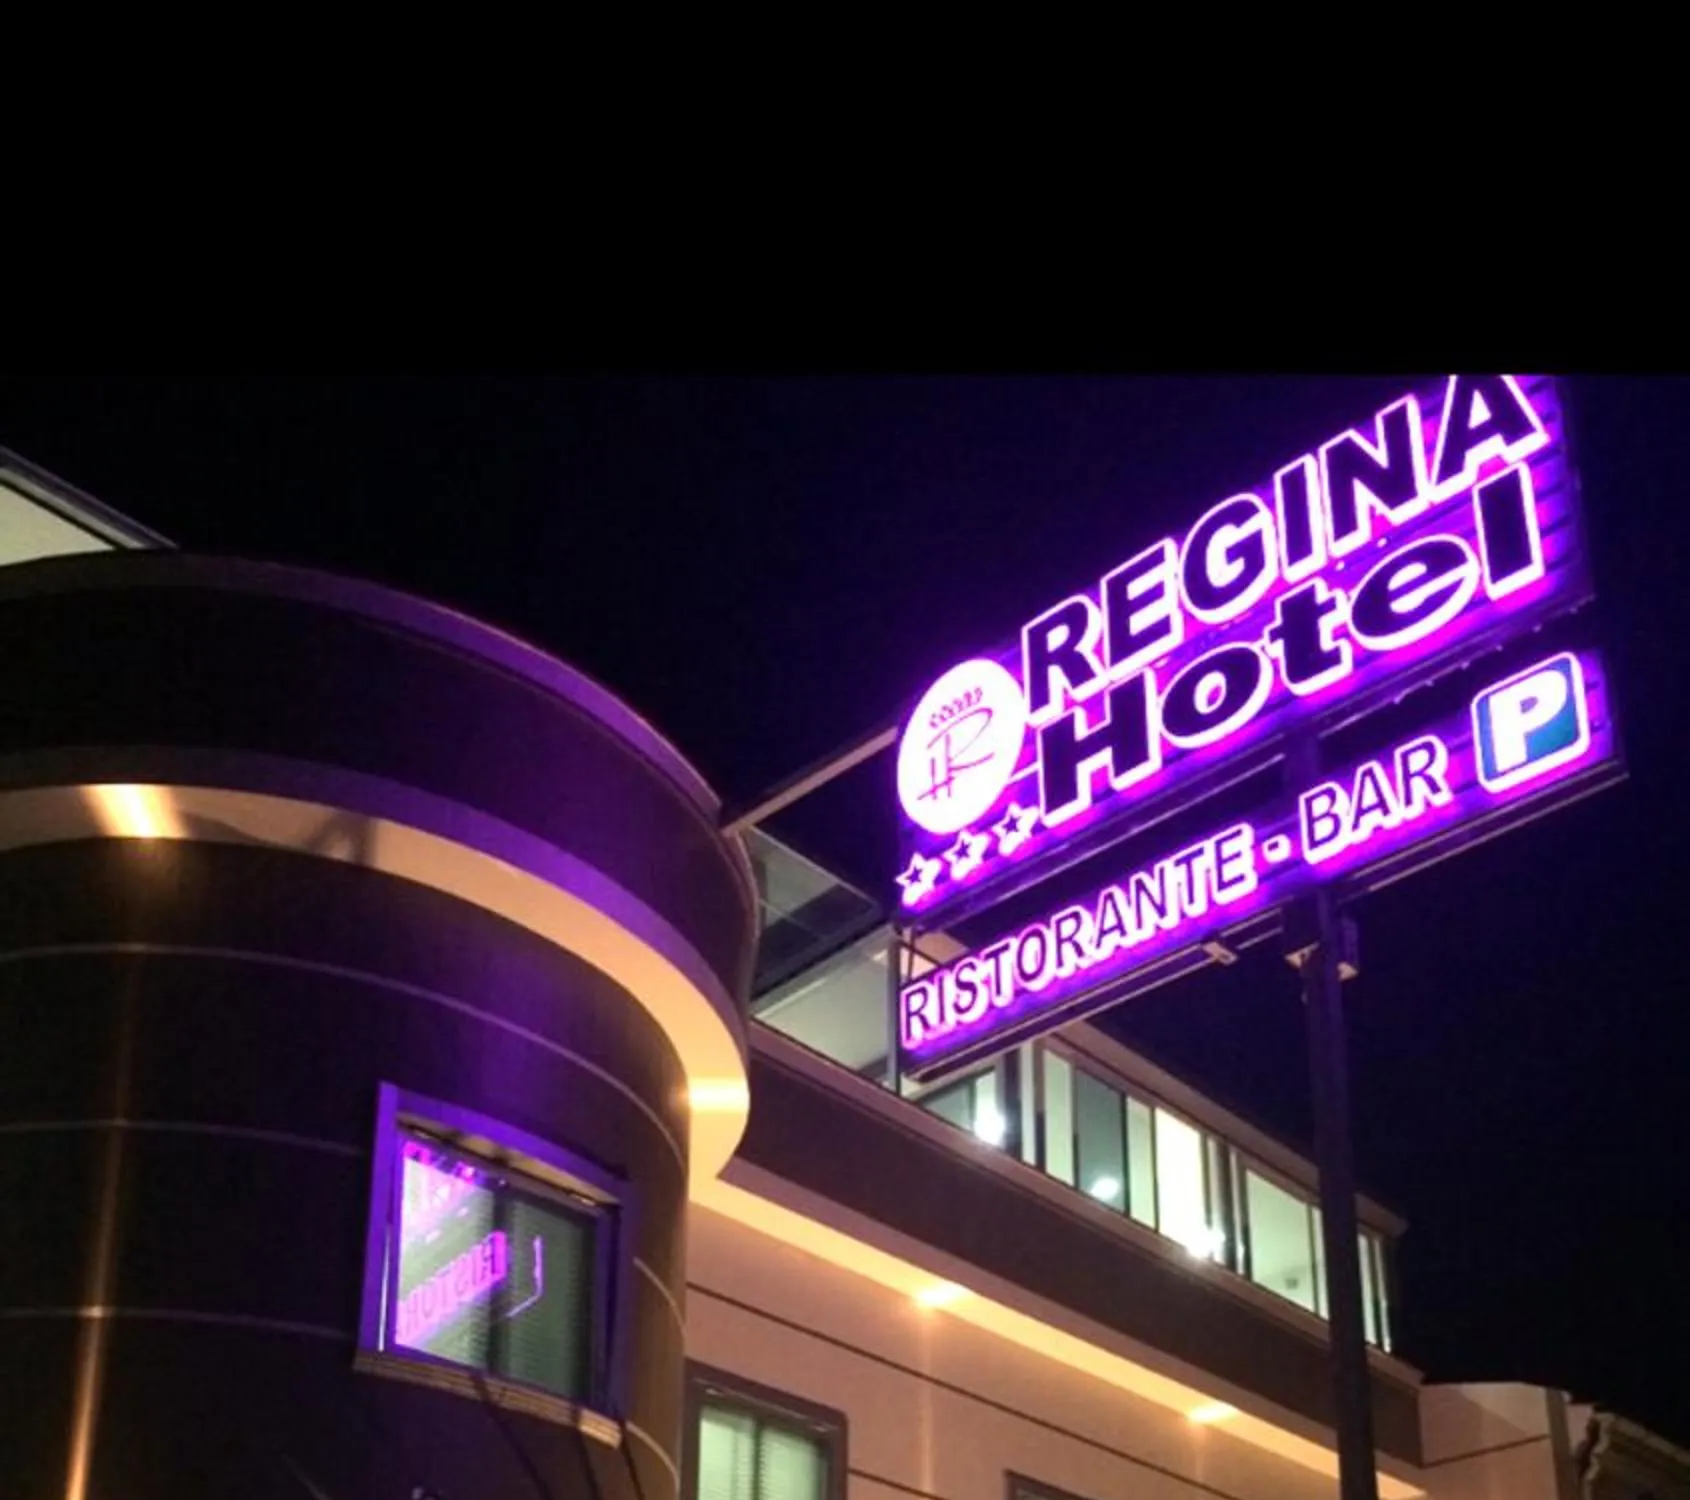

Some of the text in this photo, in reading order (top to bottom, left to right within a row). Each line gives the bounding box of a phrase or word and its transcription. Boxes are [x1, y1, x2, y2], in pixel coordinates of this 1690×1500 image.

[1022, 375, 1547, 721] REGINA
[1039, 463, 1543, 823] Hotel
[1488, 669, 1568, 773] P
[902, 826, 1255, 1046] RISTORANTE
[1301, 736, 1448, 861] BAR
